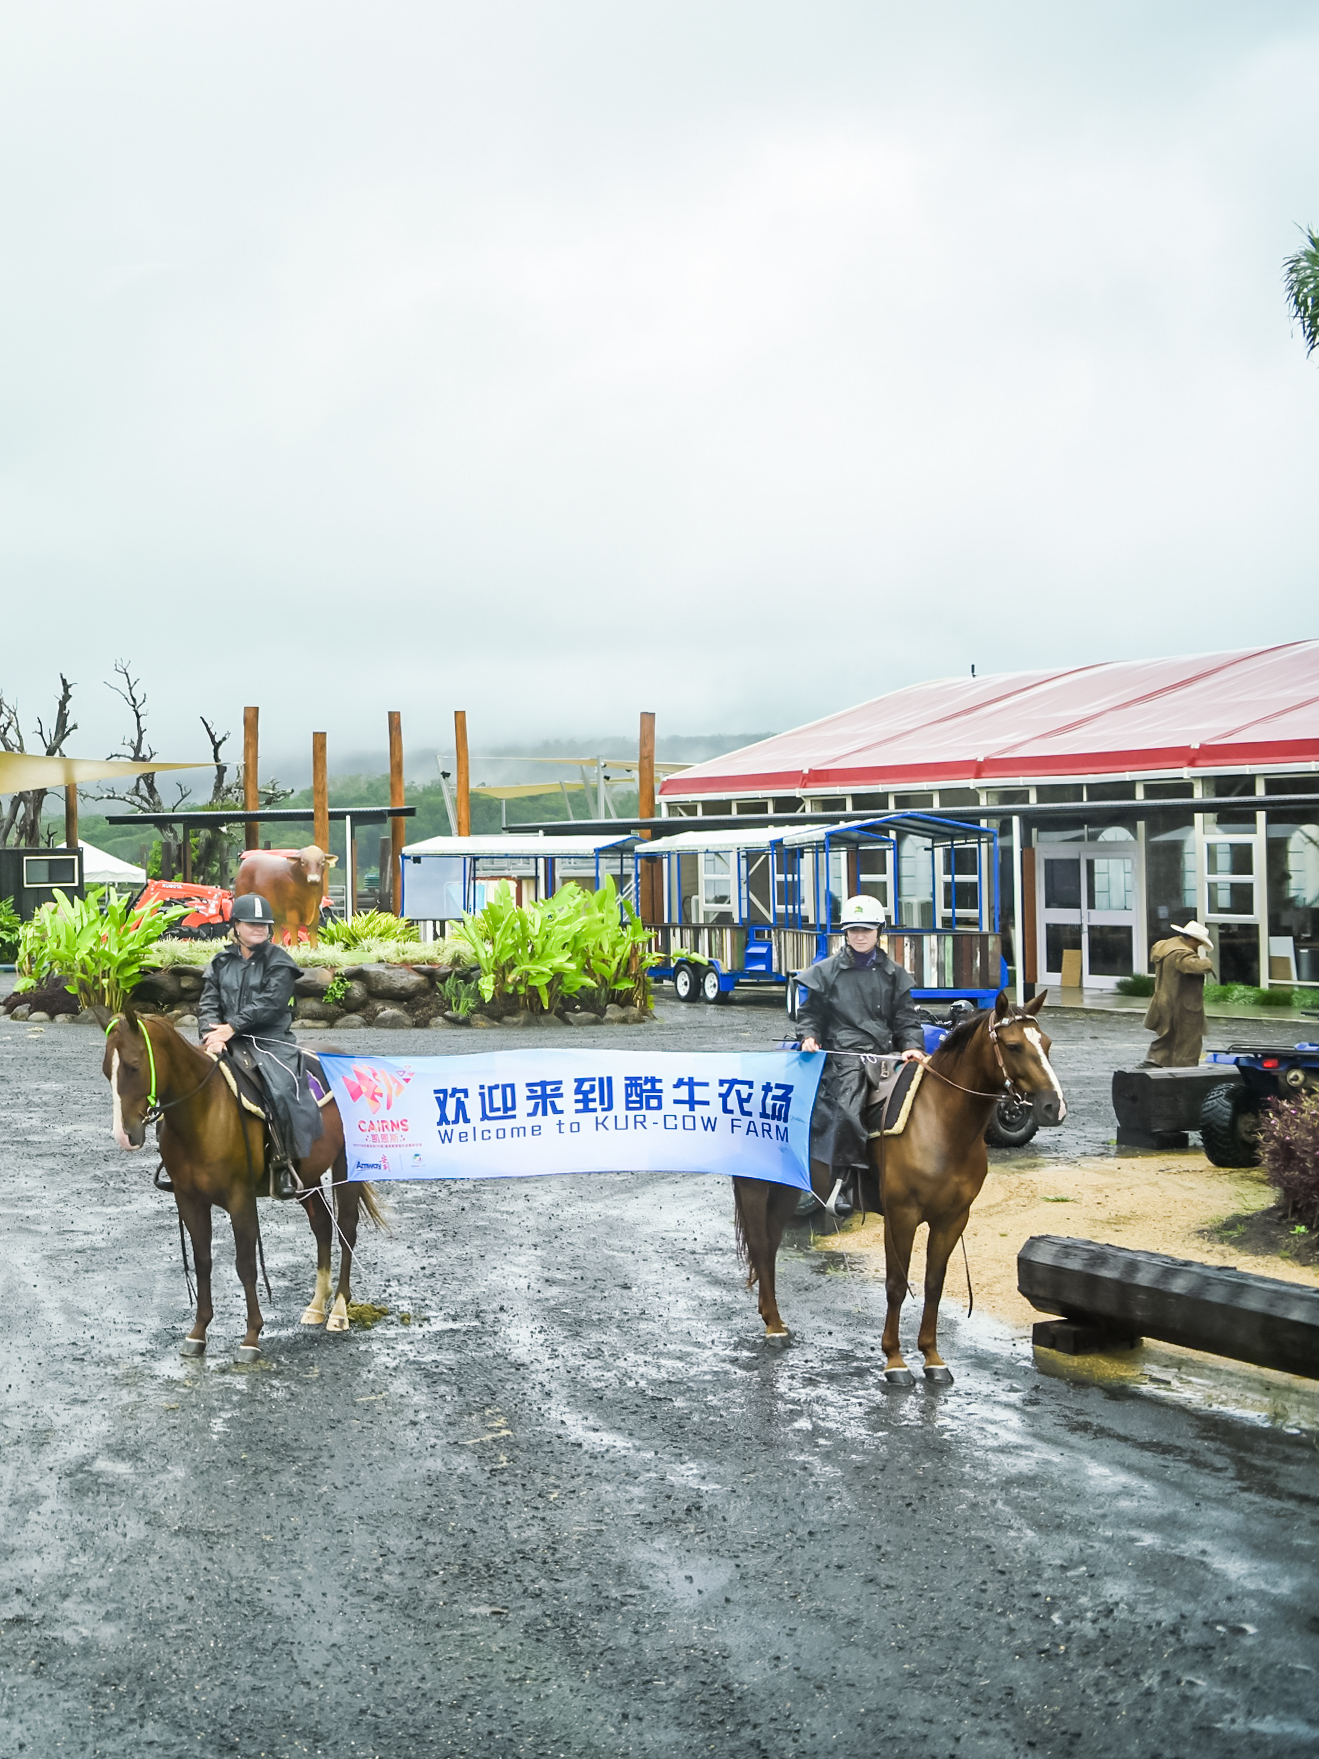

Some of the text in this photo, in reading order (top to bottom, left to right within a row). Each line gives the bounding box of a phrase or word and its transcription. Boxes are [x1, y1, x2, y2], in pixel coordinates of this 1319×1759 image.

[433, 1075, 795, 1126] 欢迎来到酷牛农场
[358, 1118, 409, 1132] CAIRNS
[438, 1114, 789, 1144] Welcome to KUR-COW FARM
[356, 1161, 382, 1170] Amway
